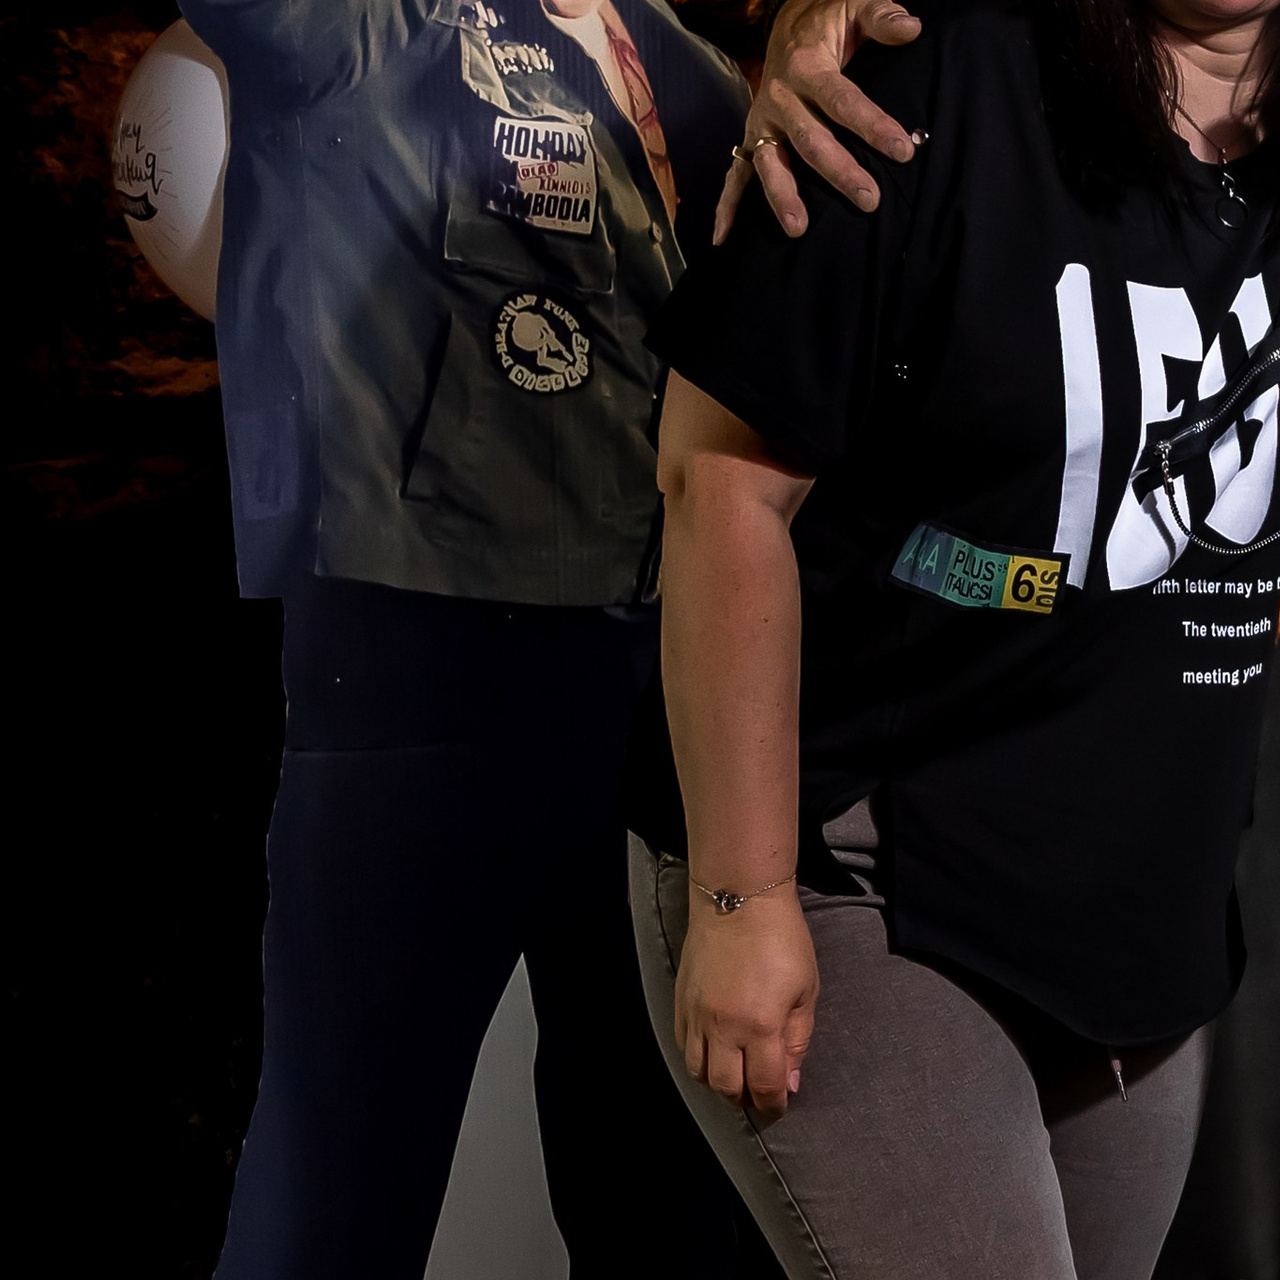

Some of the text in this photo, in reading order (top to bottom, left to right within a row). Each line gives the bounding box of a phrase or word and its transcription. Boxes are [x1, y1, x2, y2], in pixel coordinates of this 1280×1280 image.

[953, 549, 995, 582] PLUS
[1011, 563, 1038, 604] 6
[1185, 578, 1221, 594] letter
[1224, 582, 1253, 599] may
[1257, 578, 1273, 594] be
[1181, 616, 1271, 637] The twentieth
[1182, 662, 1263, 686] meeting you
